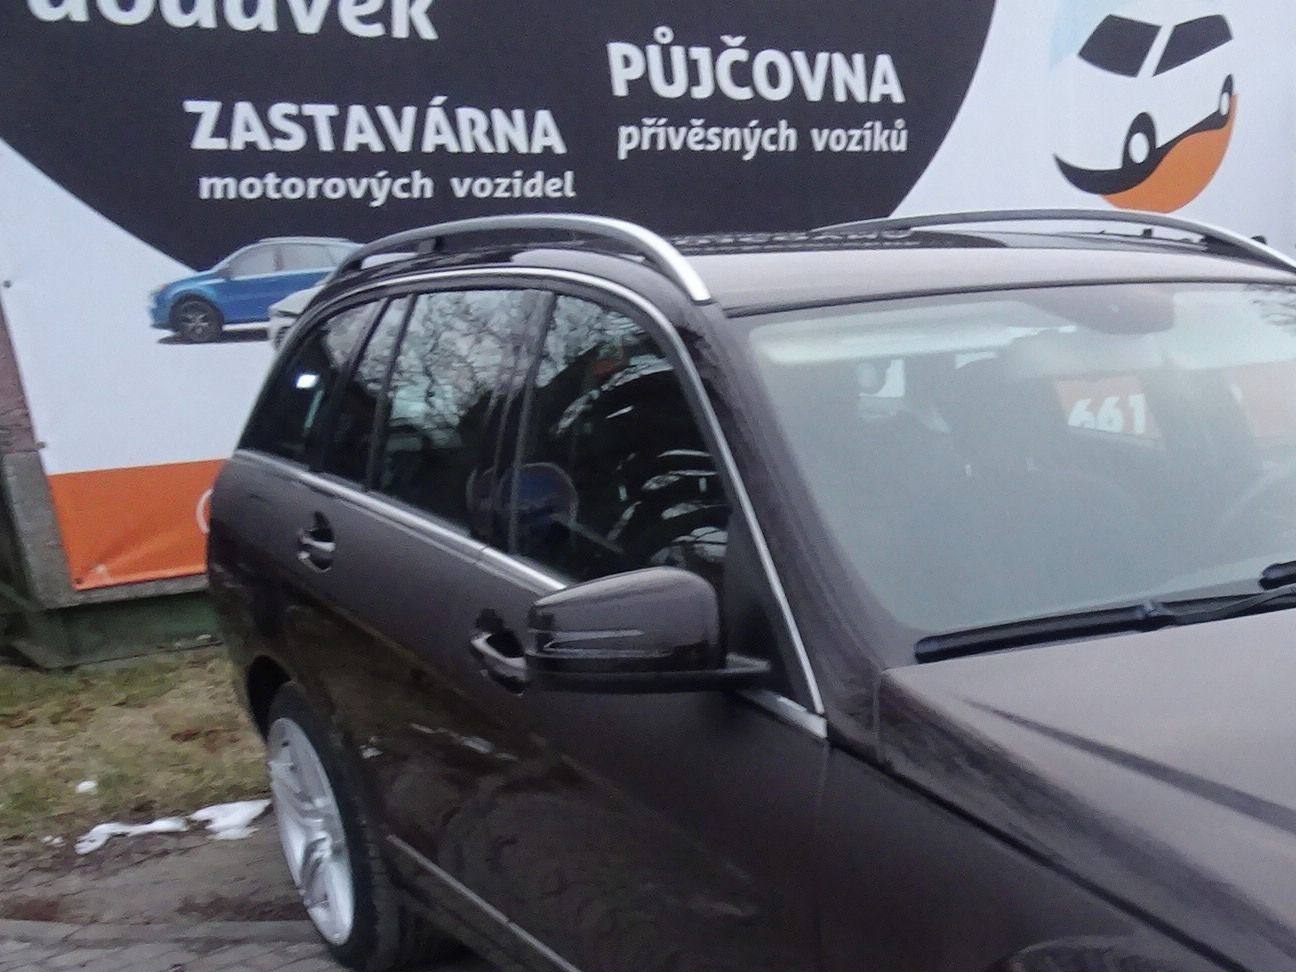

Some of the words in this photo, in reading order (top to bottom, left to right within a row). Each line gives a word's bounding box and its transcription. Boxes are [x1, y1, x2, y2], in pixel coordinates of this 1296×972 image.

[606, 25, 906, 103] PŮJČOVNA
[182, 95, 567, 154] ZASTAVÁRNA
[617, 117, 798, 161] přívěsných
[809, 118, 908, 152] vozíků
[198, 170, 434, 208] motorových
[450, 170, 577, 198] vozidel
[1067, 393, 1147, 434] 661
